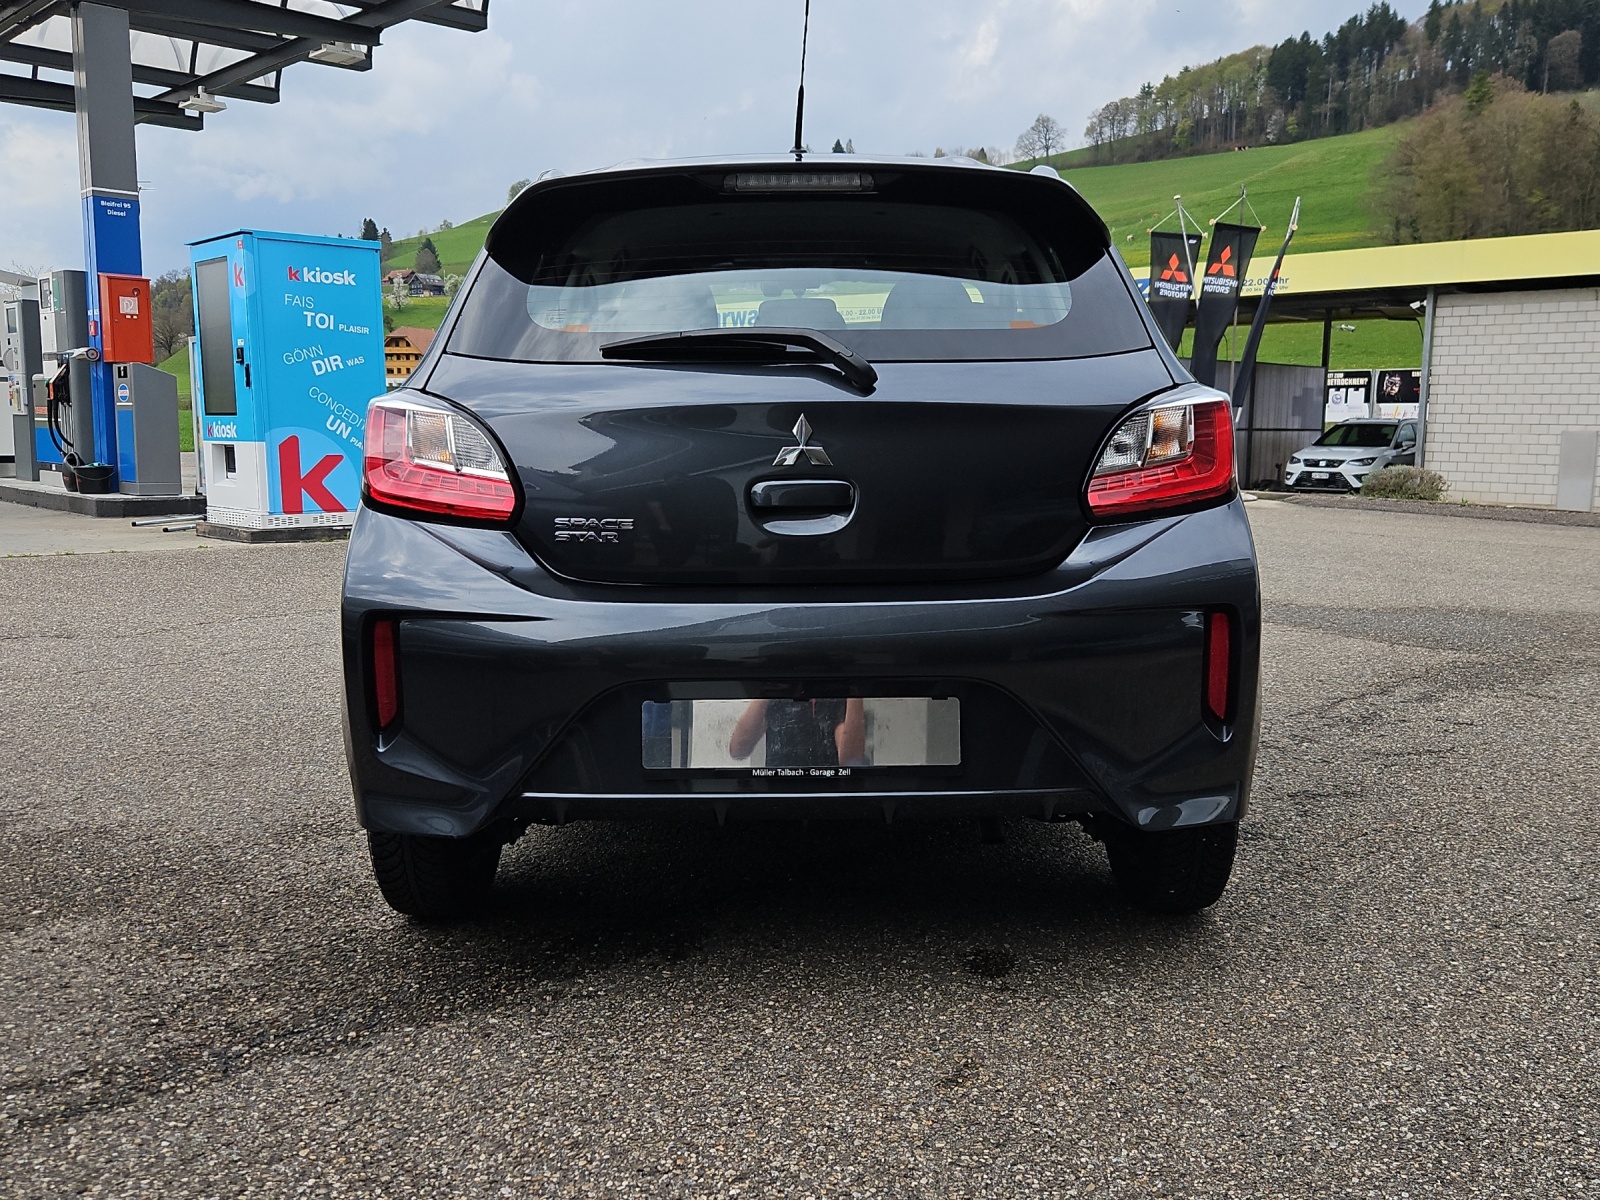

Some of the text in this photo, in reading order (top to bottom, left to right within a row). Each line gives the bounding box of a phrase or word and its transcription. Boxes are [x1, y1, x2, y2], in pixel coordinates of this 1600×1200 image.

[100, 200, 123, 208] Bleifrei
[107, 209, 127, 217] Diesel
[233, 261, 244, 287] k
[303, 266, 357, 286] kiosk
[1203, 284, 1231, 295] MOTORS
[284, 293, 315, 309] FAIS
[858, 308, 876, 316] 22.00
[303, 310, 370, 335] TOI PLAISIR
[282, 344, 324, 365] GÖNN
[311, 354, 365, 376] DIR WAS
[212, 420, 238, 439] kiosk
[325, 414, 352, 439] UN
[349, 437, 364, 451] PIA
[278, 434, 348, 515] k
[554, 517, 635, 530] SPACE
[554, 530, 620, 543] STAR
[752, 768, 776, 776] Müller
[776, 768, 804, 776] Talbach
[809, 768, 835, 777] Garage
[838, 768, 851, 776] Zell
